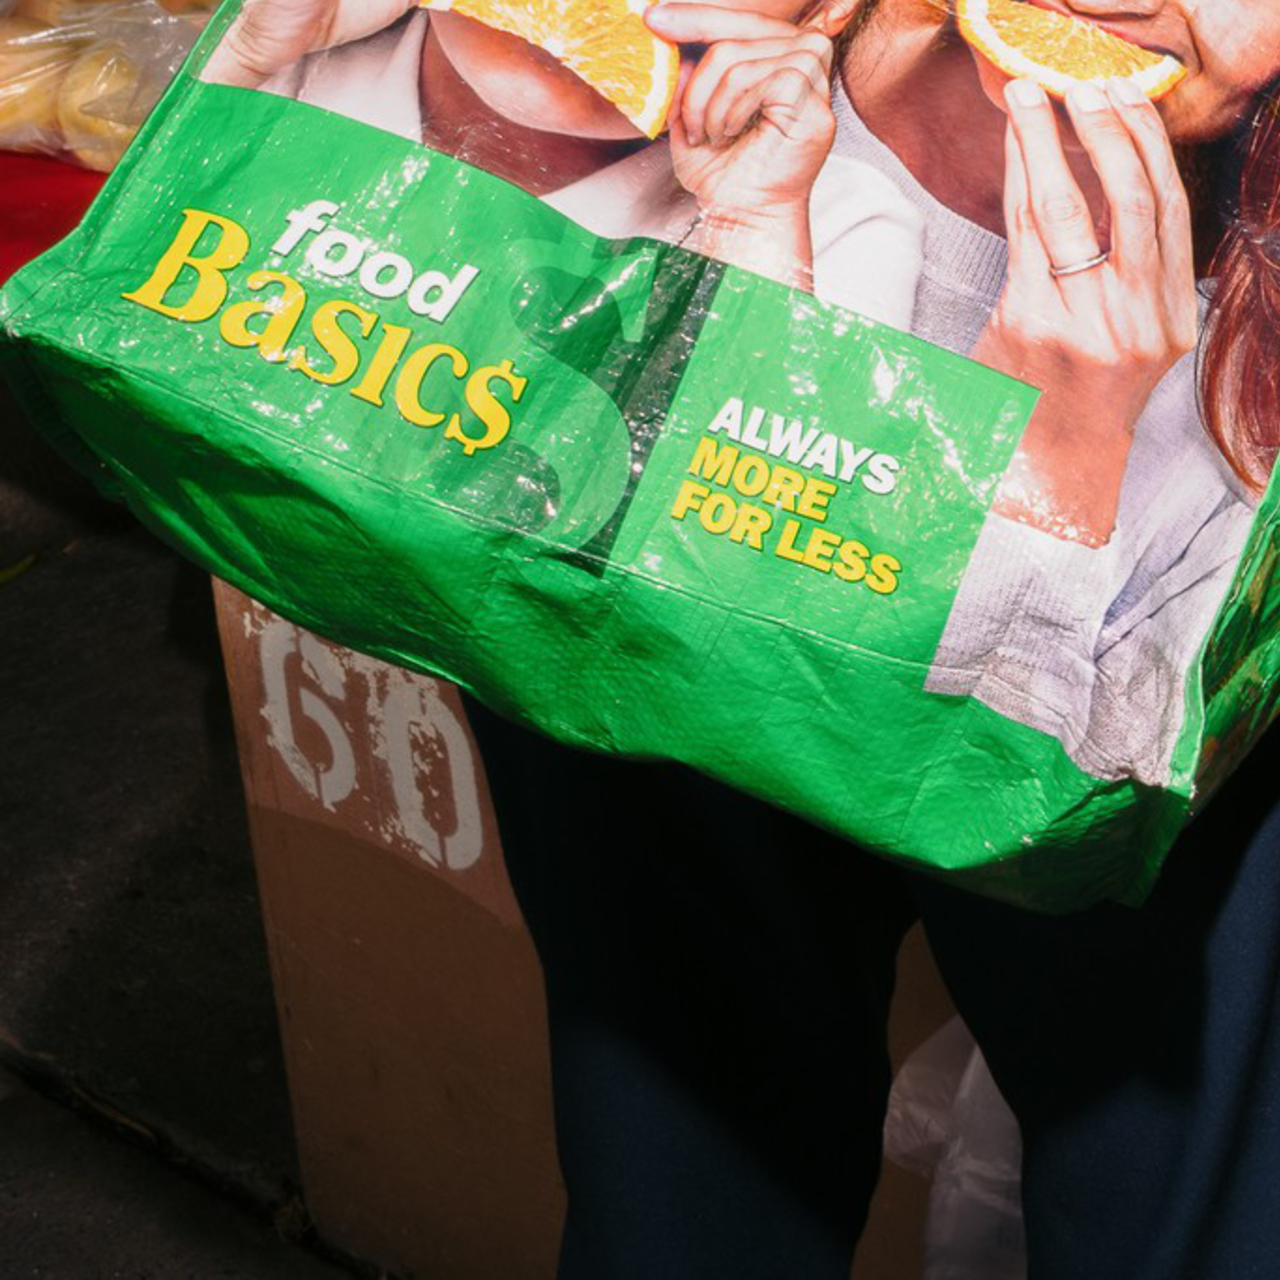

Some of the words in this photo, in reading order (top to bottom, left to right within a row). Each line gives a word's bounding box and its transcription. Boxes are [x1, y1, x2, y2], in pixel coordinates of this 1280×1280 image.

[270, 199, 481, 324] food
[688, 435, 839, 524] MORE
[707, 396, 901, 496] ALWAYS
[670, 479, 774, 552] FOR
[775, 517, 903, 596] LESS
